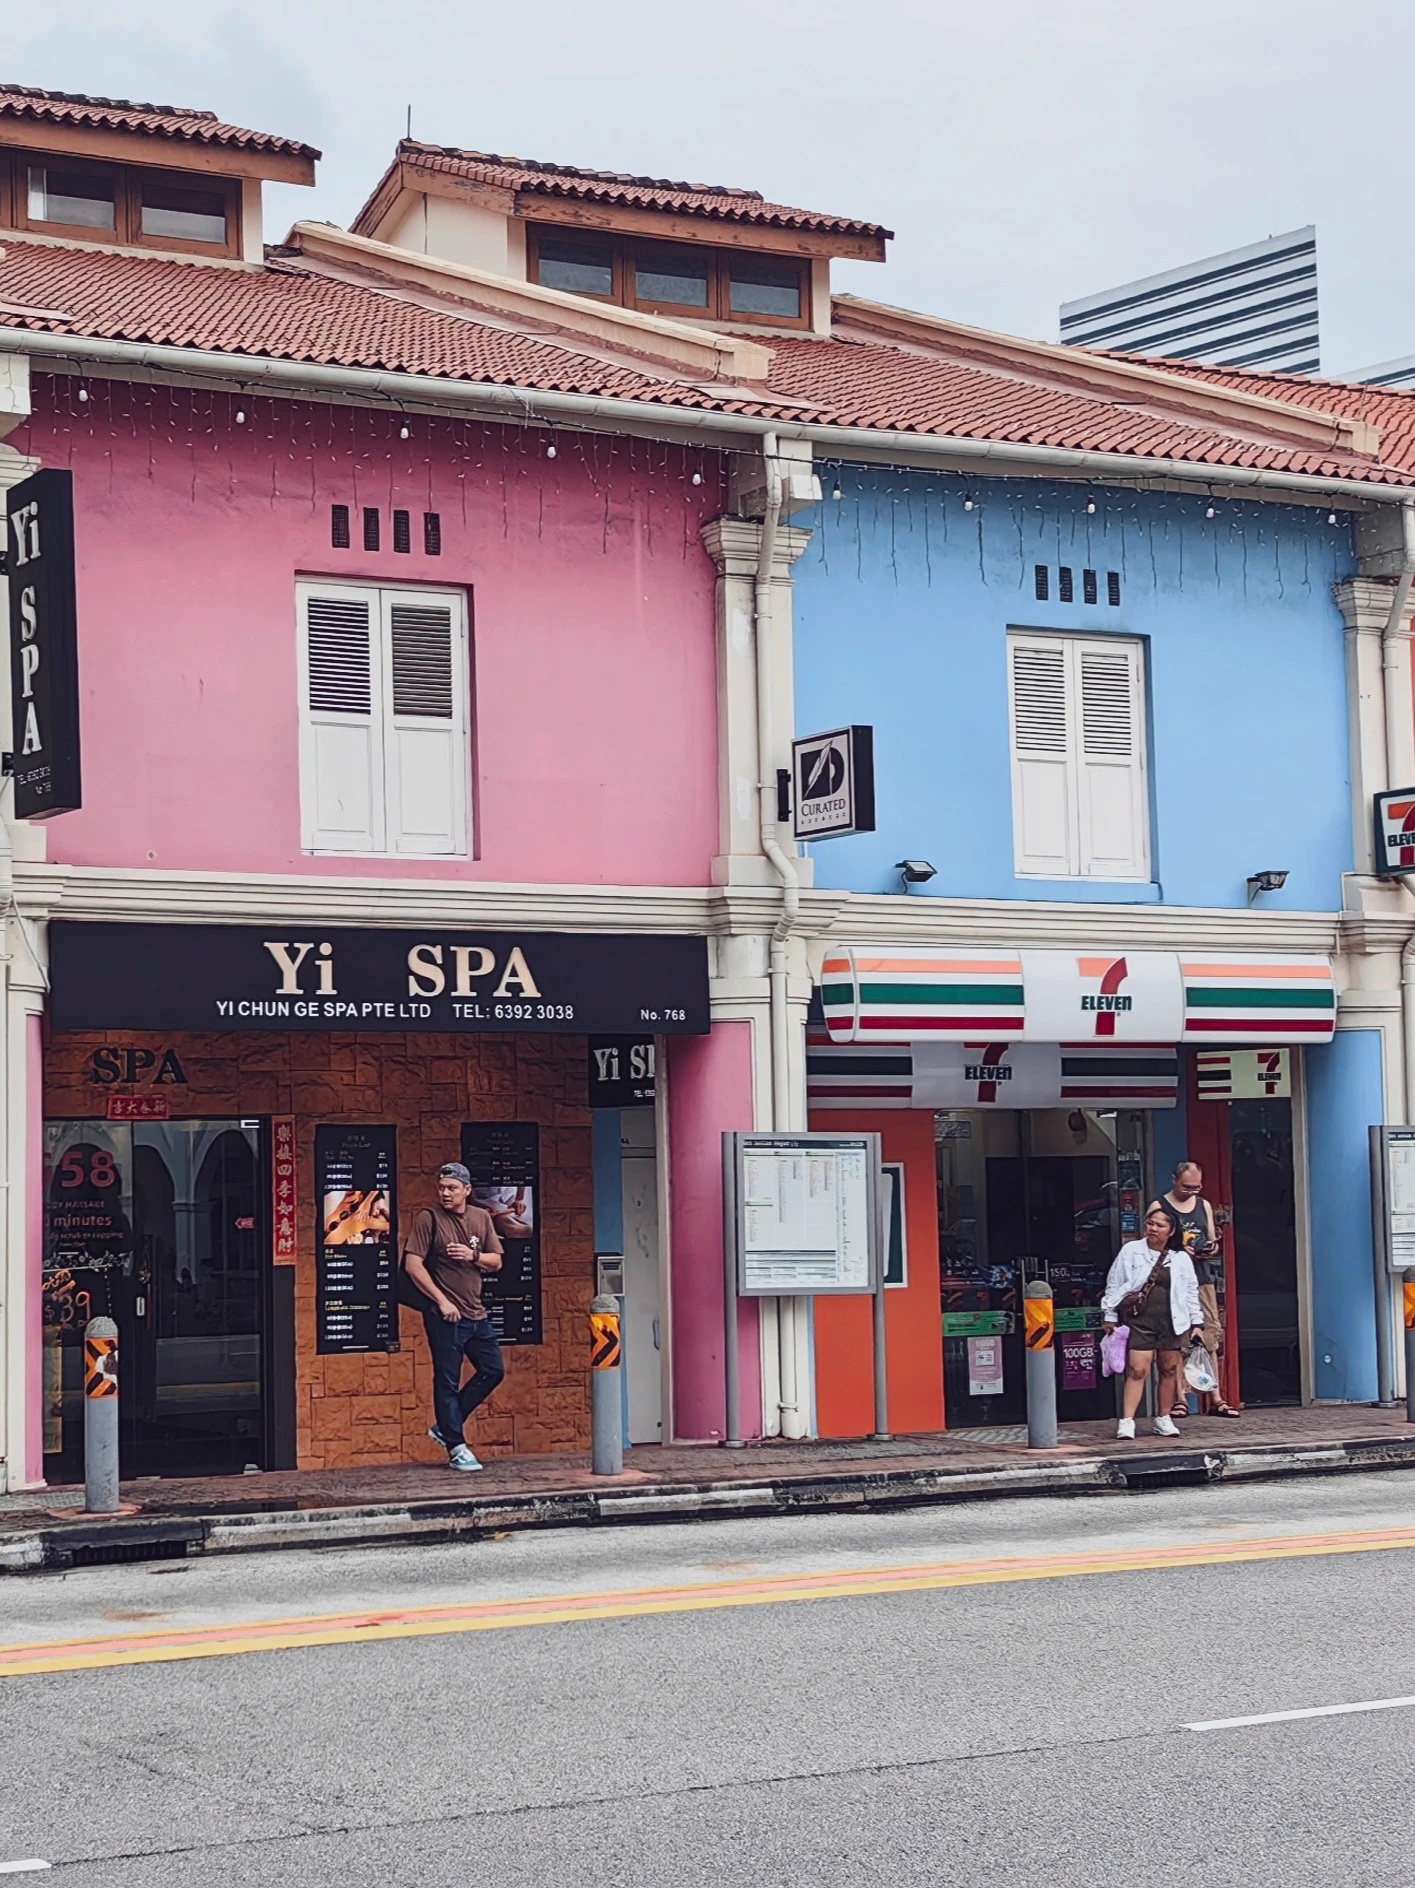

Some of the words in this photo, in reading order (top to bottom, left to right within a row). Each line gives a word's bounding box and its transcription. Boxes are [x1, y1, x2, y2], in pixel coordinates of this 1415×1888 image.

[10, 501, 41, 566] Yi
[20, 585, 42, 755] SPA
[801, 798, 846, 817] CURATED
[263, 941, 338, 995] Yi
[407, 943, 542, 998] SPA
[216, 1000, 234, 1016] YI
[237, 1001, 290, 1017] CHUN
[294, 1001, 320, 1017] GE
[323, 1002, 358, 1017] SPA
[361, 1003, 396, 1018] PTE
[399, 1003, 431, 1018] LTD
[452, 1004, 491, 1019] TEL:
[494, 1004, 532, 1019] 6392
[536, 1005, 574, 1019] 3038
[664, 1009, 686, 1020] 768
[92, 1047, 189, 1085] SPA
[593, 1047, 620, 1081] Yi
[61, 1151, 115, 1188] 58
[53, 1214, 113, 1227] minutes
